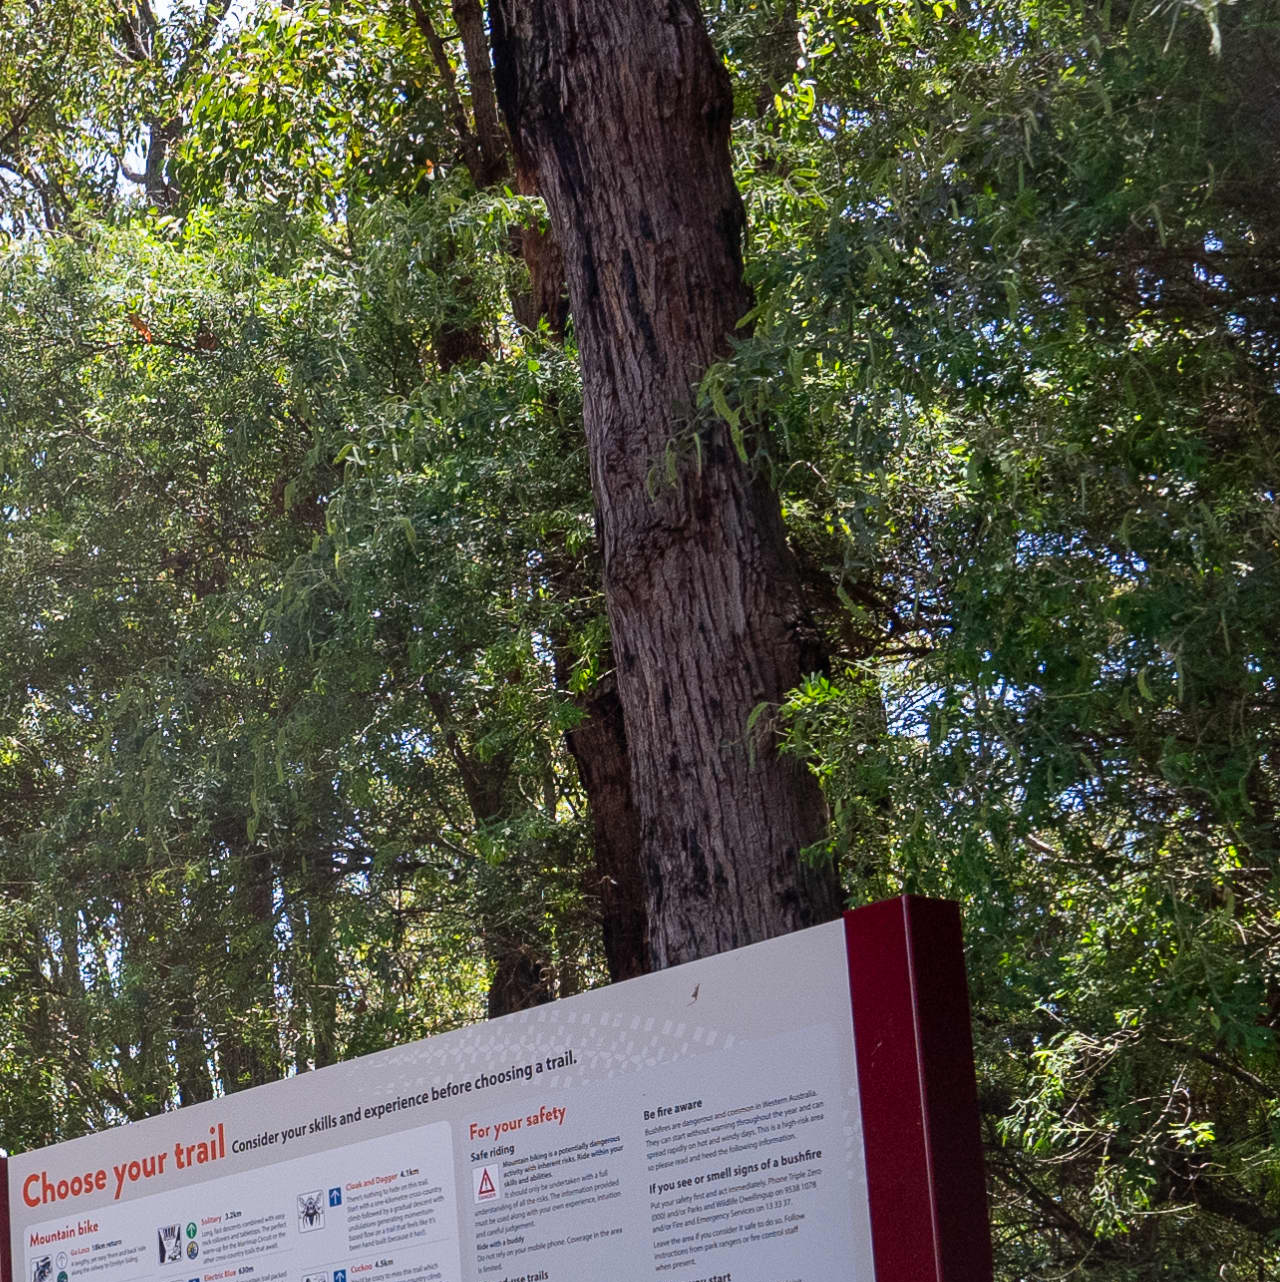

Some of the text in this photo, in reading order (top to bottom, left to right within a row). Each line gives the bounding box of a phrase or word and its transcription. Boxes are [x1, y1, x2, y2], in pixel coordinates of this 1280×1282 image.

[232, 1050, 576, 1153] Consider your skills and experience before choosing a trail.
[643, 1100, 702, 1120] Be fire aware
[469, 1105, 565, 1140] For your safety
[23, 1123, 224, 1207] Choose your trail
[470, 1145, 514, 1162] Safe riding
[649, 1149, 821, 1194] If you see or smell signs of a bushfire
[201, 1211, 241, 1225] Solitary 3.2km
[30, 1219, 98, 1247] Mountain bike
[350, 1259, 393, 1273] Cuckoo 4.5km
[527, 1270, 548, 1282] trails
